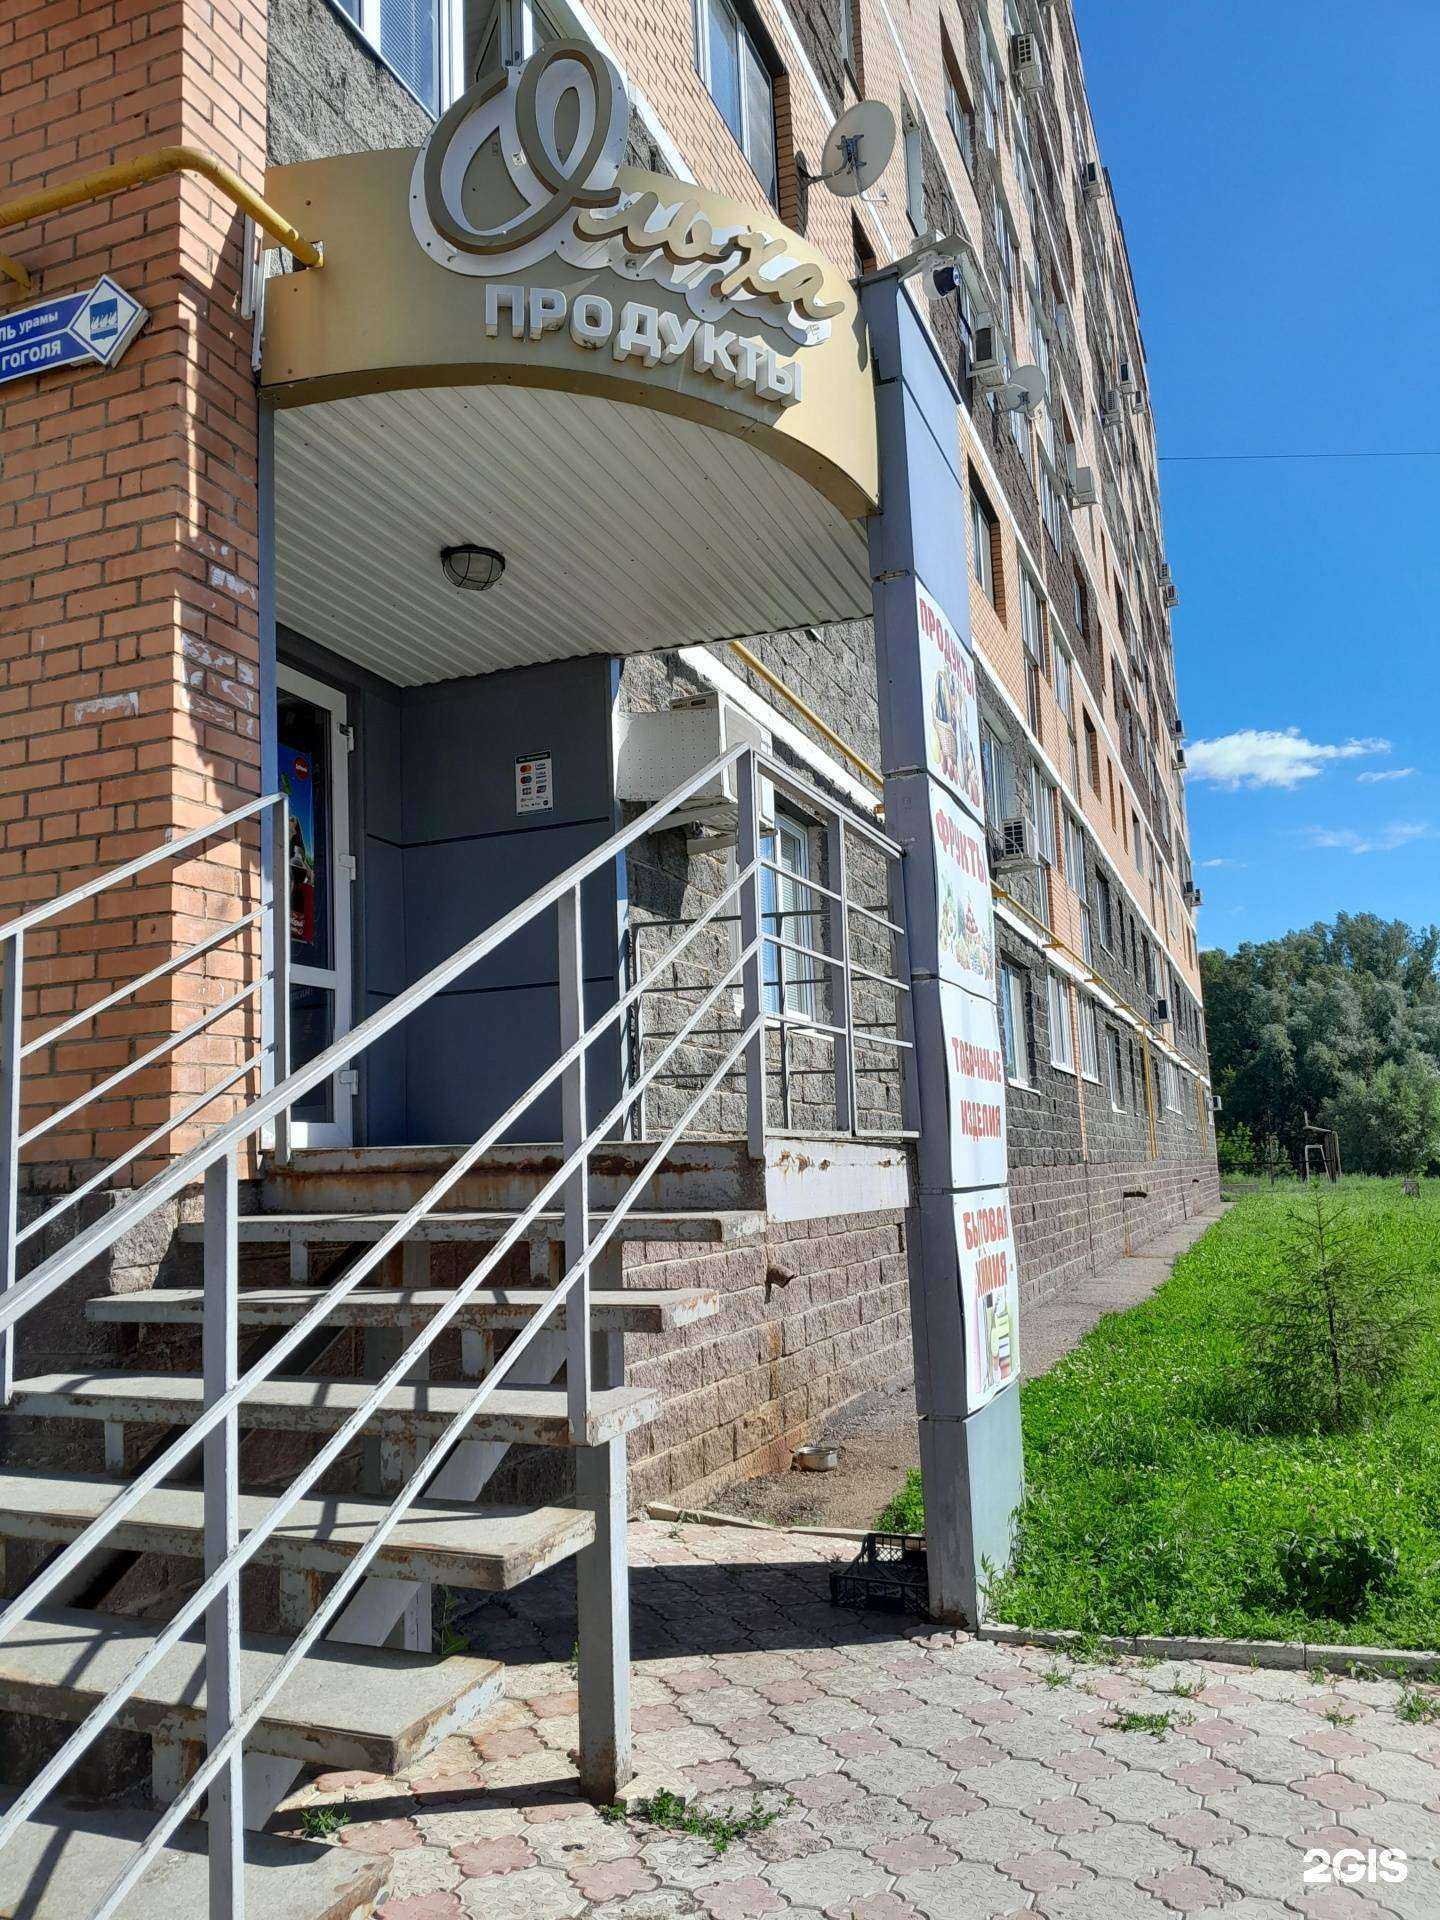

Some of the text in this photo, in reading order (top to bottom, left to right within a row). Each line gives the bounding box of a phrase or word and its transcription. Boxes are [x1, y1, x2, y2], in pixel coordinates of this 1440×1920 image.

[19, 311, 58, 336] урамы
[484, 283, 803, 405] ПРОДУКТЫ
[2, 340, 61, 371] ГОГОЛЯ
[918, 597, 976, 700] ПРОДУКТЫ
[934, 808, 988, 887] ФРУКТЫ
[951, 1036, 1003, 1083] ТАБАЧНЫЕ
[959, 1099, 1002, 1143] ИЗДЕЛИЯ
[975, 1249, 1008, 1299] ХИМИЯ
